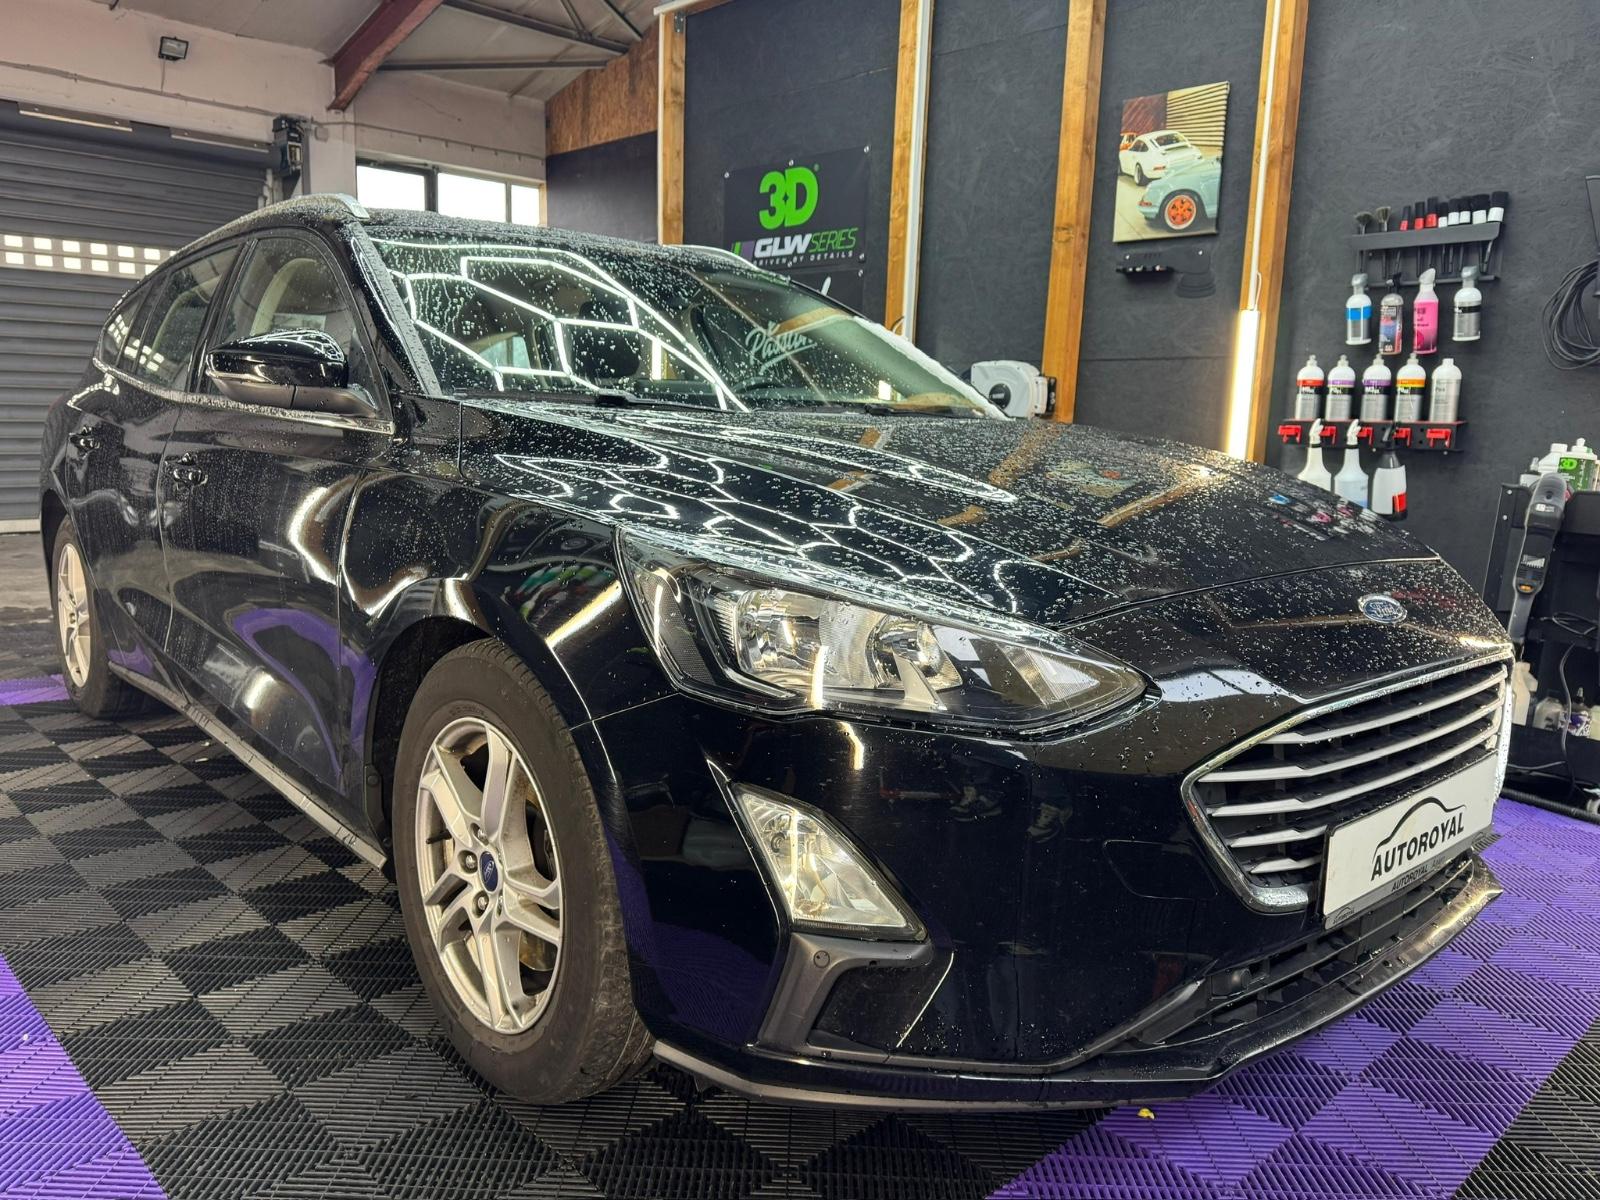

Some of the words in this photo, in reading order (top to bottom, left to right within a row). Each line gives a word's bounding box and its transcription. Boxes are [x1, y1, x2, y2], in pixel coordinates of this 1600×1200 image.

[759, 166, 819, 230] 3D
[754, 258, 786, 267] DRIVEN
[793, 256, 804, 264] BY
[810, 250, 854, 262] DETAILS
[1560, 458, 1578, 471] 3D
[1371, 812, 1465, 882] AUTOROYAL
[1391, 865, 1428, 892] AUTOROYAL
